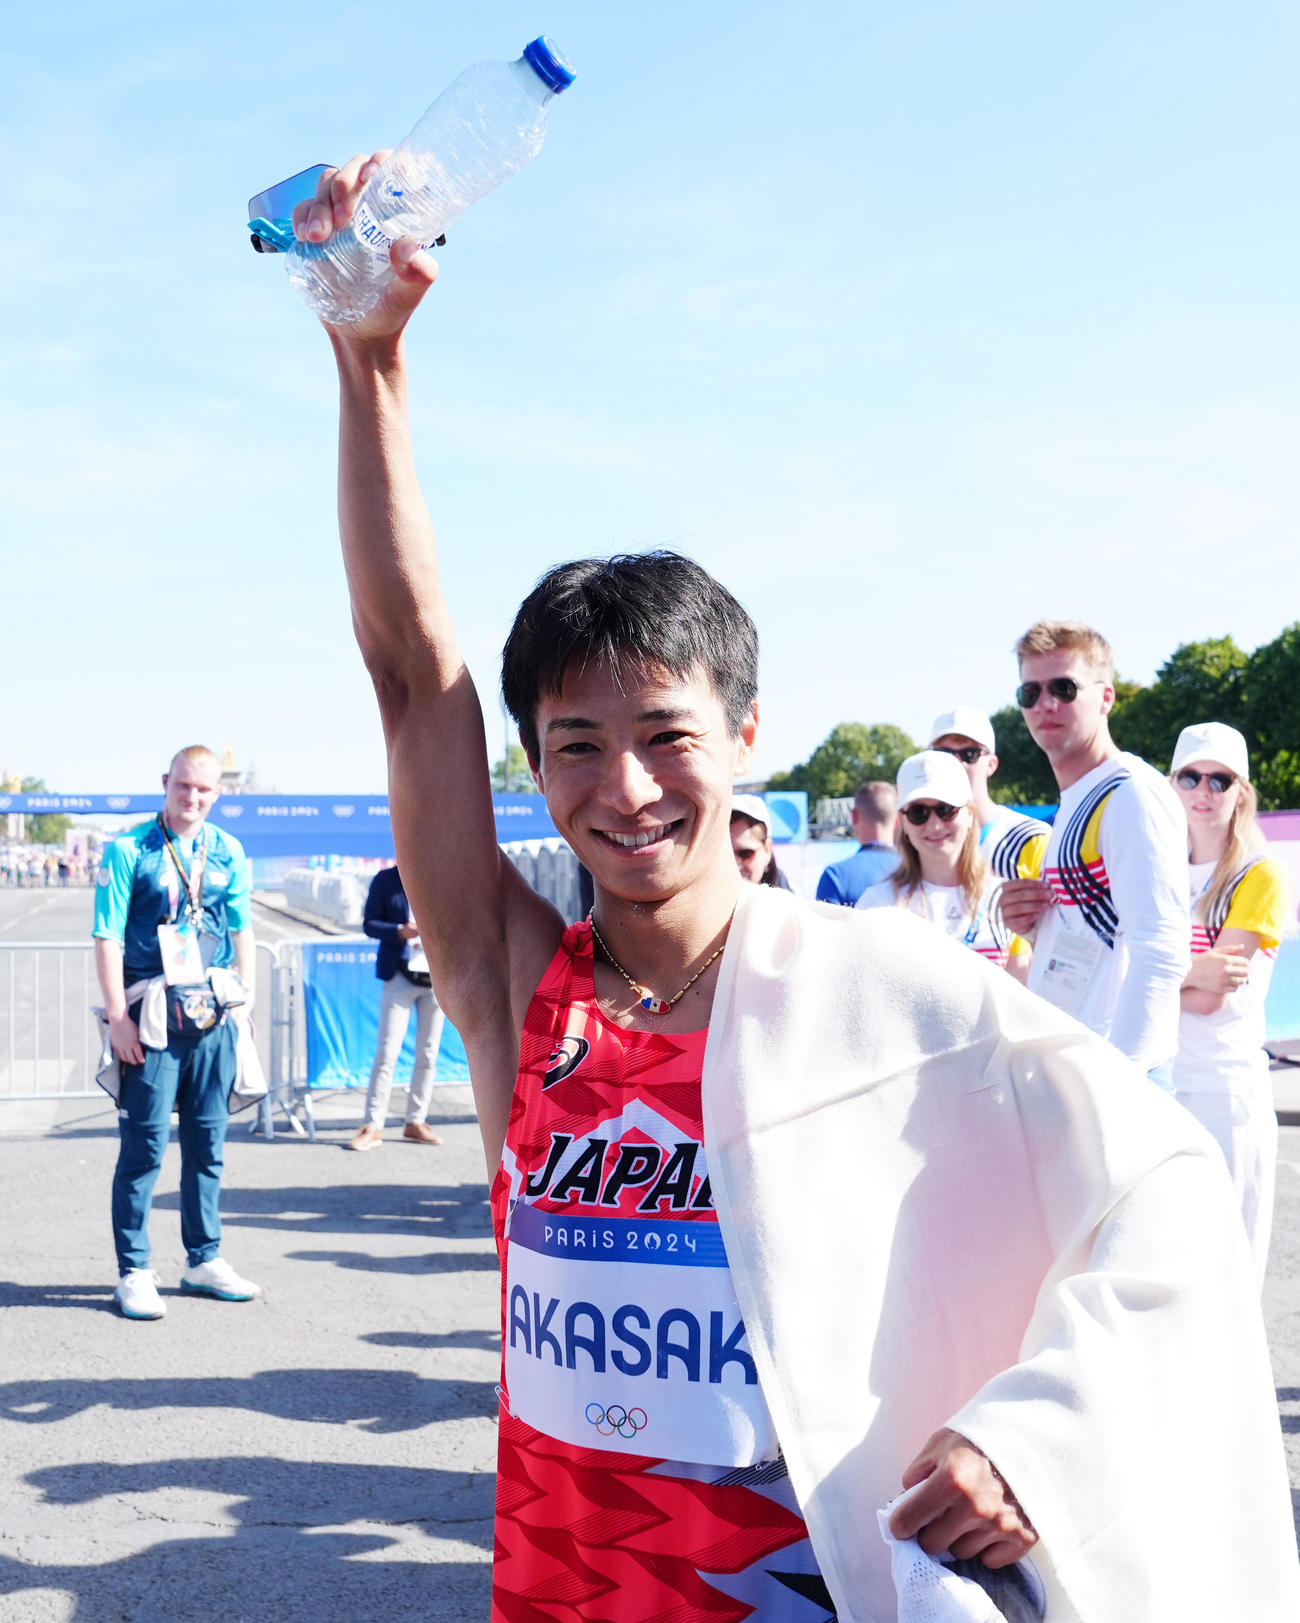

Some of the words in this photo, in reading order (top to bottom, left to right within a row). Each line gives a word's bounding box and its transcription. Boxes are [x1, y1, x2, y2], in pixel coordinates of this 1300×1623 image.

[368, 806, 390, 816] PAR
[359, 952, 377, 963] 20
[627, 1231, 696, 1253] 2024
[510, 1284, 758, 1385] AKASAK
